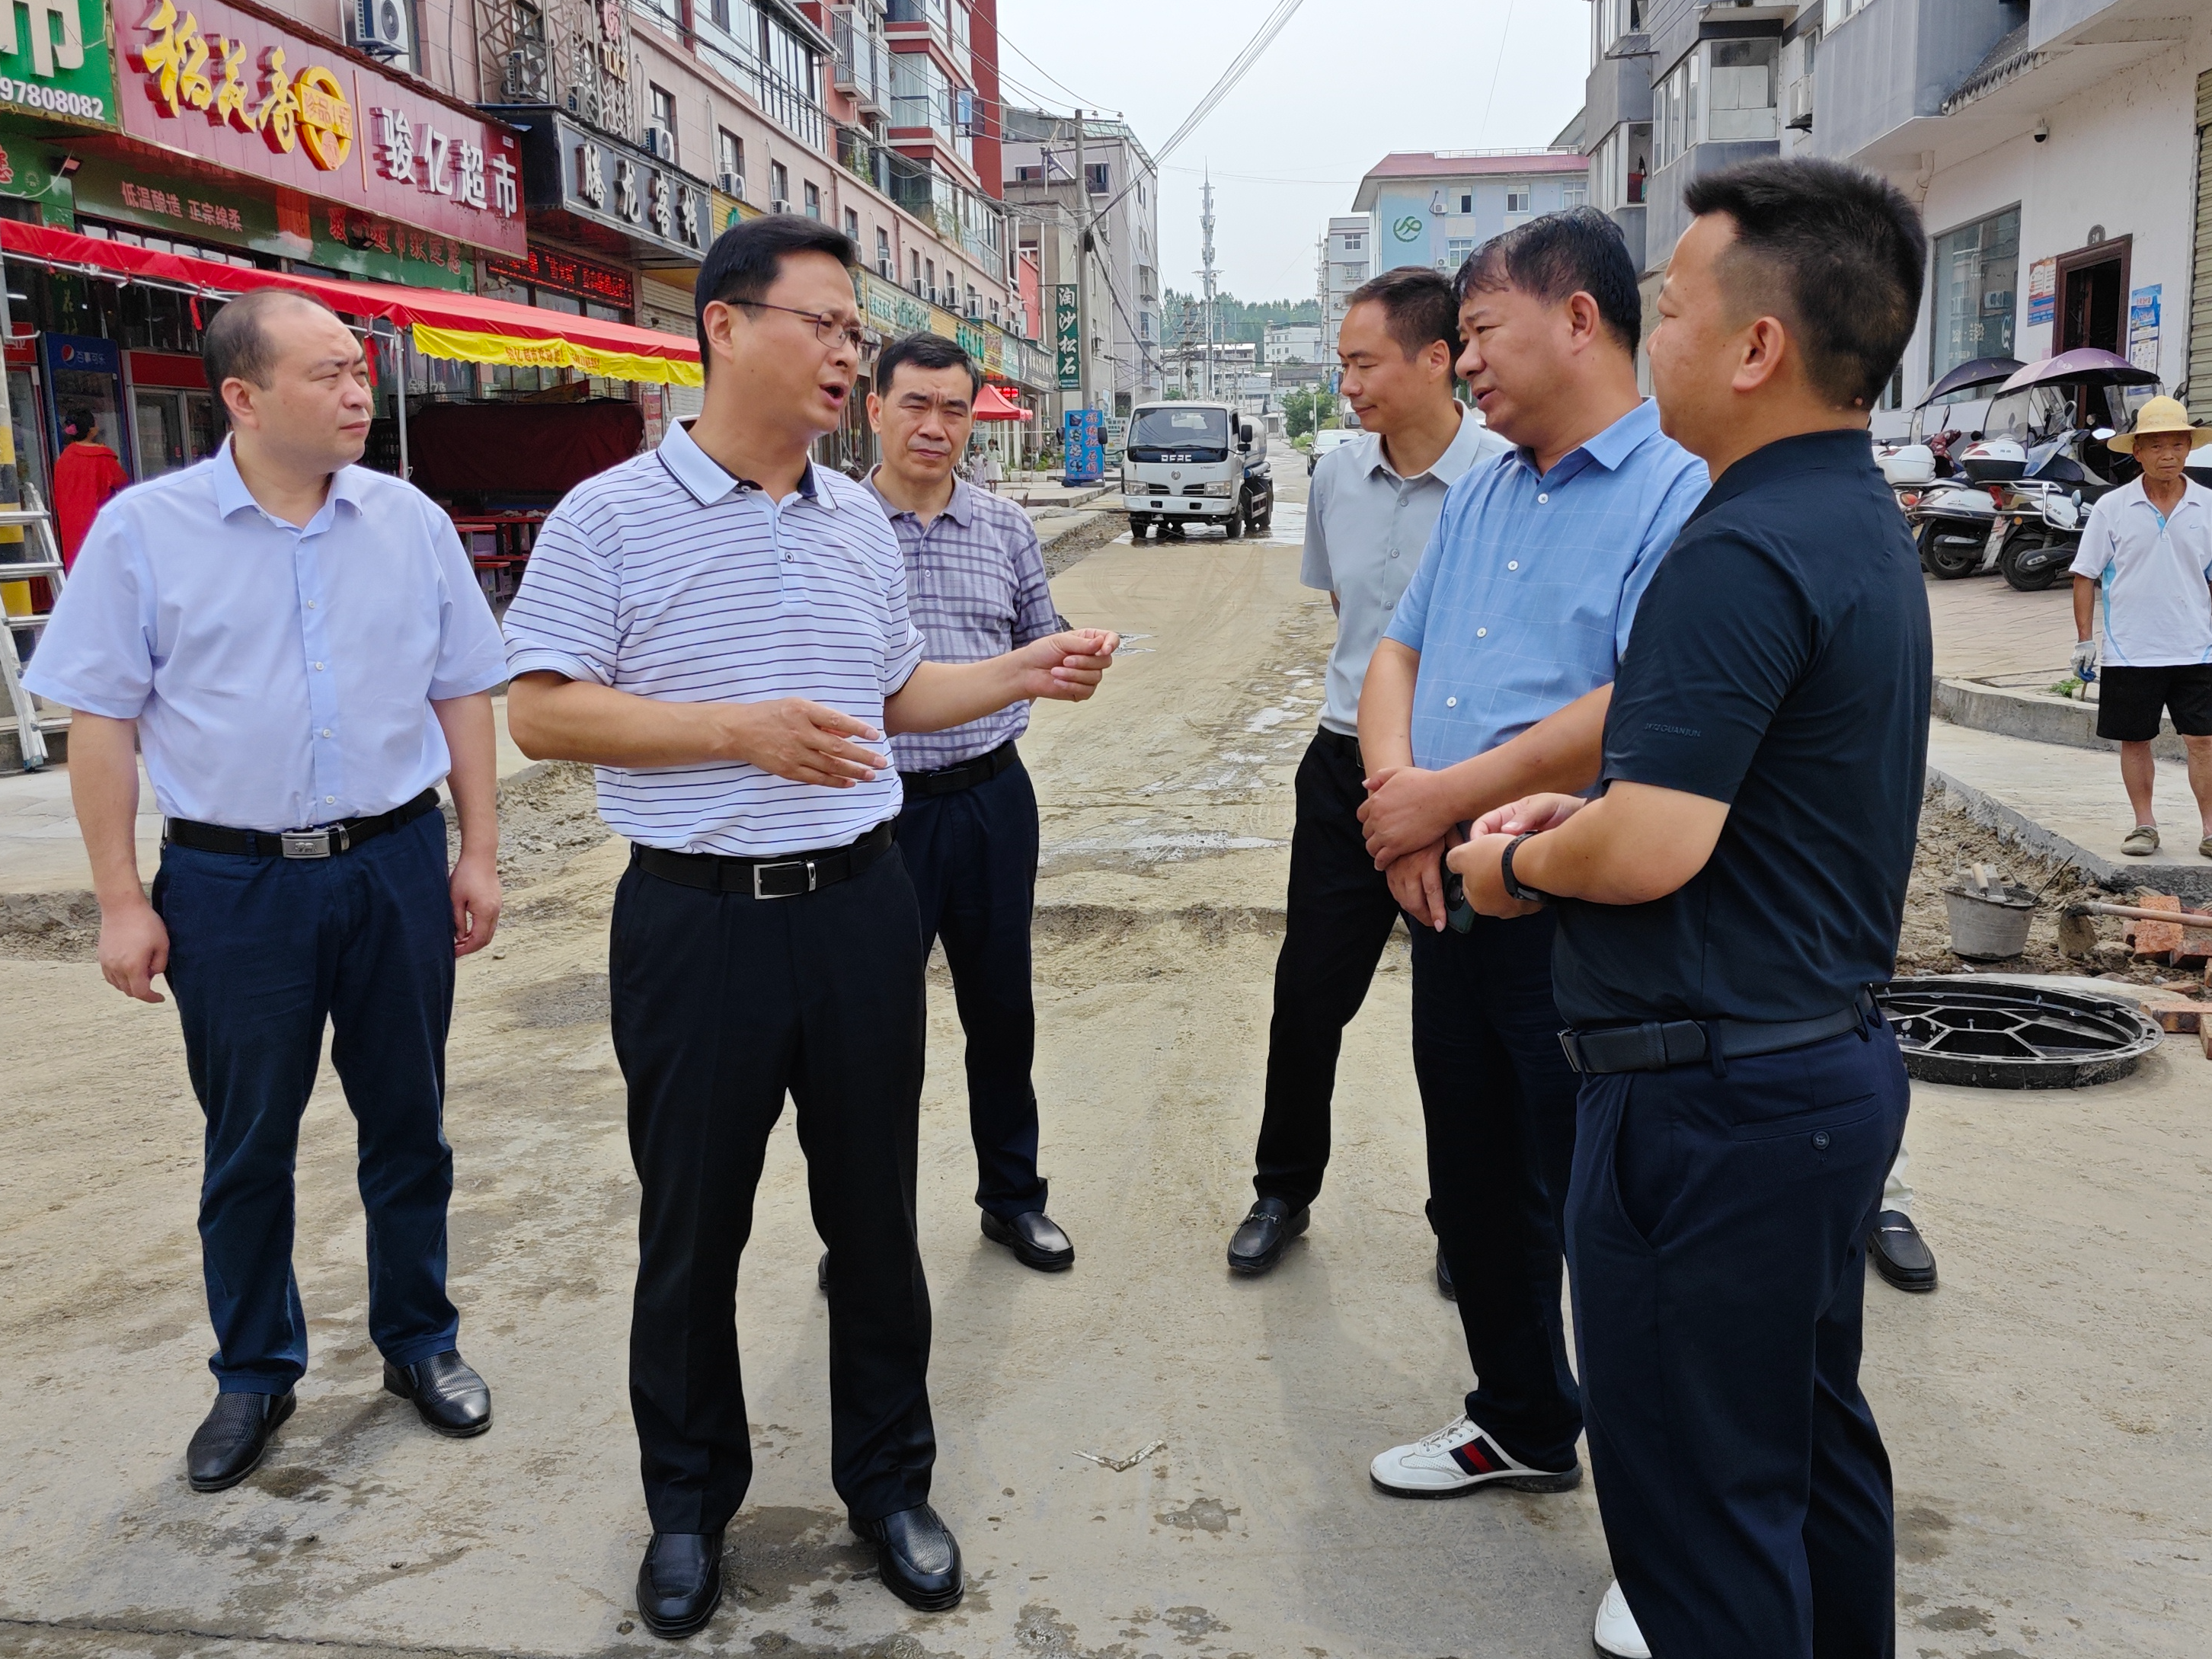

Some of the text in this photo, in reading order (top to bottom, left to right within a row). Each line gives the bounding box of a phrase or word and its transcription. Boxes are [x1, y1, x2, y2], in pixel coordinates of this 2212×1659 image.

[381, 106, 517, 219] 骏亿超市
[120, 181, 243, 233] 低温酿造 正宗绵柔
[1058, 286, 1077, 376] 淘沙松石
[76, 350, 106, 365] 百事可乐
[1161, 454, 1192, 462] DFAC
